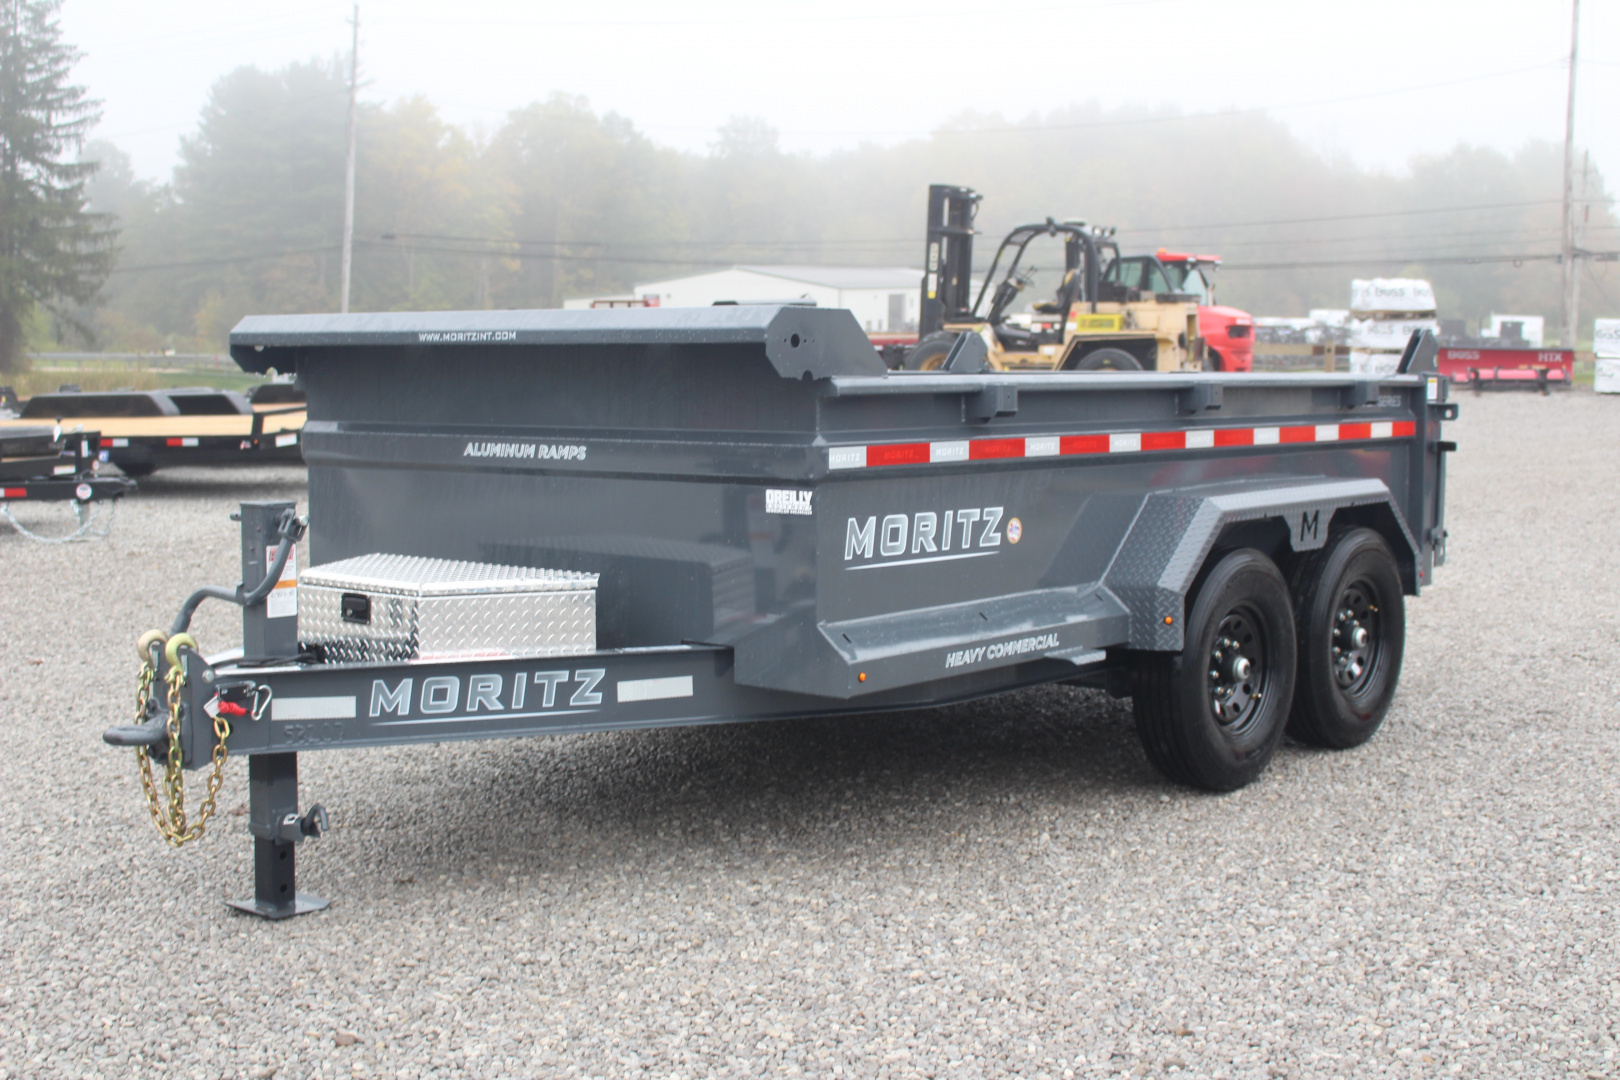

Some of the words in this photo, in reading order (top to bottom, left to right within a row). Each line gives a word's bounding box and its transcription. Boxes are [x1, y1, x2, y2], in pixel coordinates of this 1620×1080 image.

[418, 331, 517, 342] WWW.MORITZINT.COM
[463, 442, 537, 459] ALUMINUM
[538, 445, 588, 461] RAMPS
[844, 506, 1004, 561] MORITZ
[1300, 509, 1320, 542] M
[945, 647, 987, 669] HEAVY
[986, 633, 1060, 661] COMMERCIAL
[368, 667, 607, 718] MORITZ
